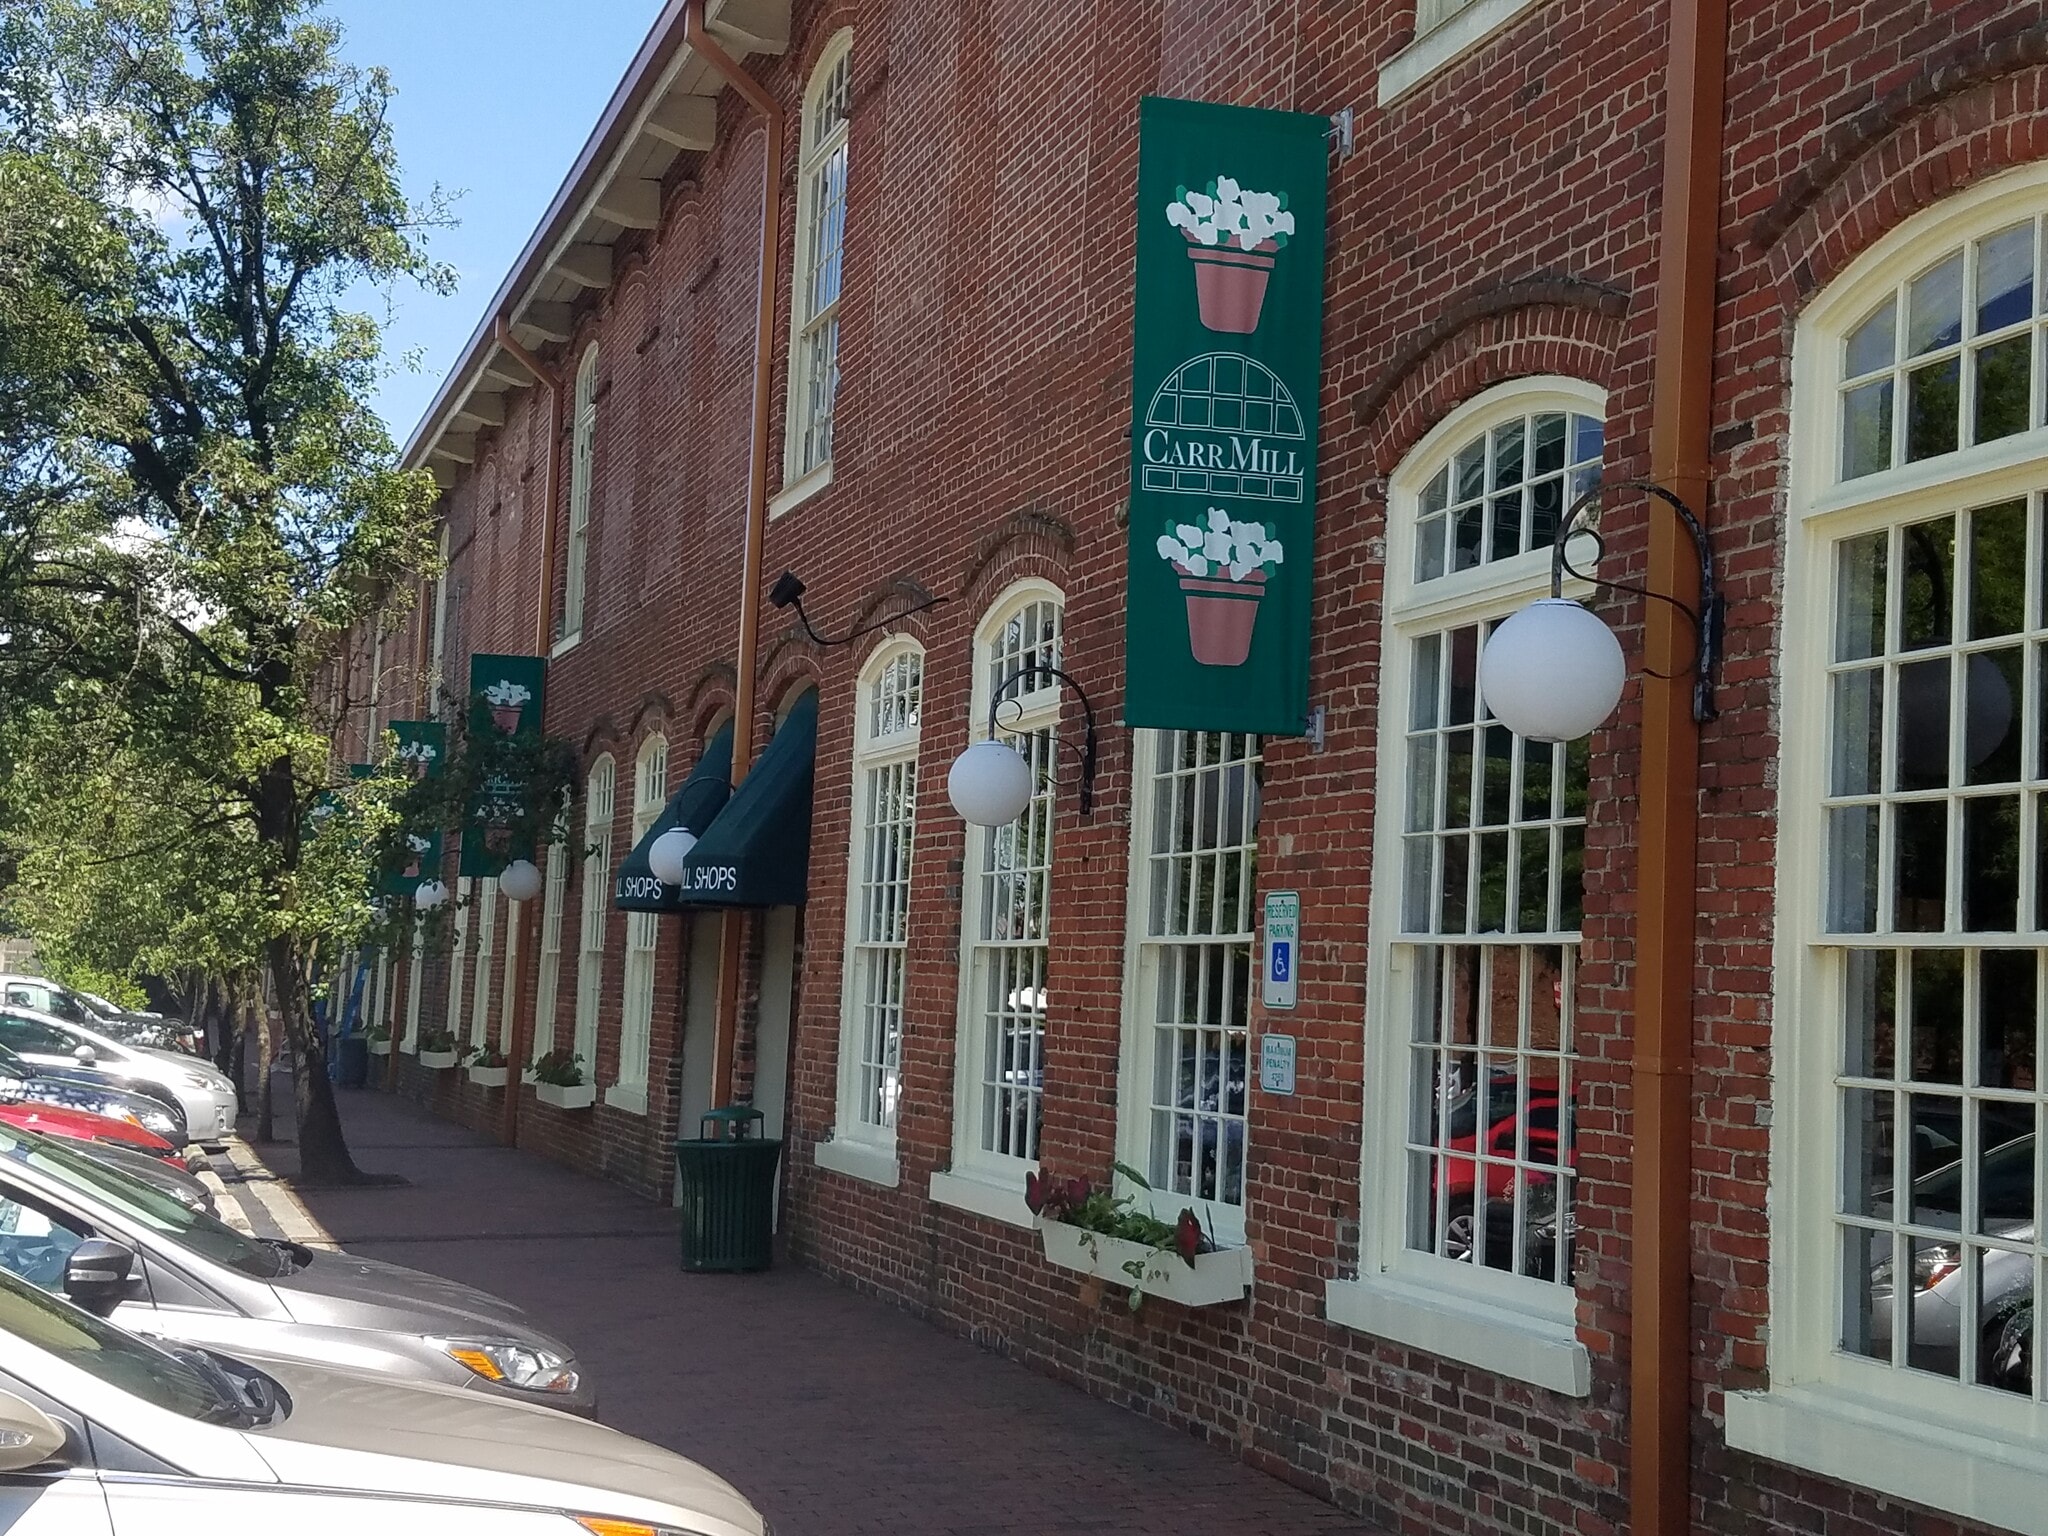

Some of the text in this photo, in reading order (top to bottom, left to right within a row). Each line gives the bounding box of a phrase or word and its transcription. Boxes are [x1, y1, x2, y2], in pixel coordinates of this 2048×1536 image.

[694, 866, 737, 891] SHOPS
[625, 876, 663, 900] SHOPS
[1267, 904, 1298, 918] RESERVED
[1269, 924, 1294, 938] PARKING
[1265, 1045, 1291, 1056] MAXIMUM
[1265, 1058, 1290, 1069] PENALTY
